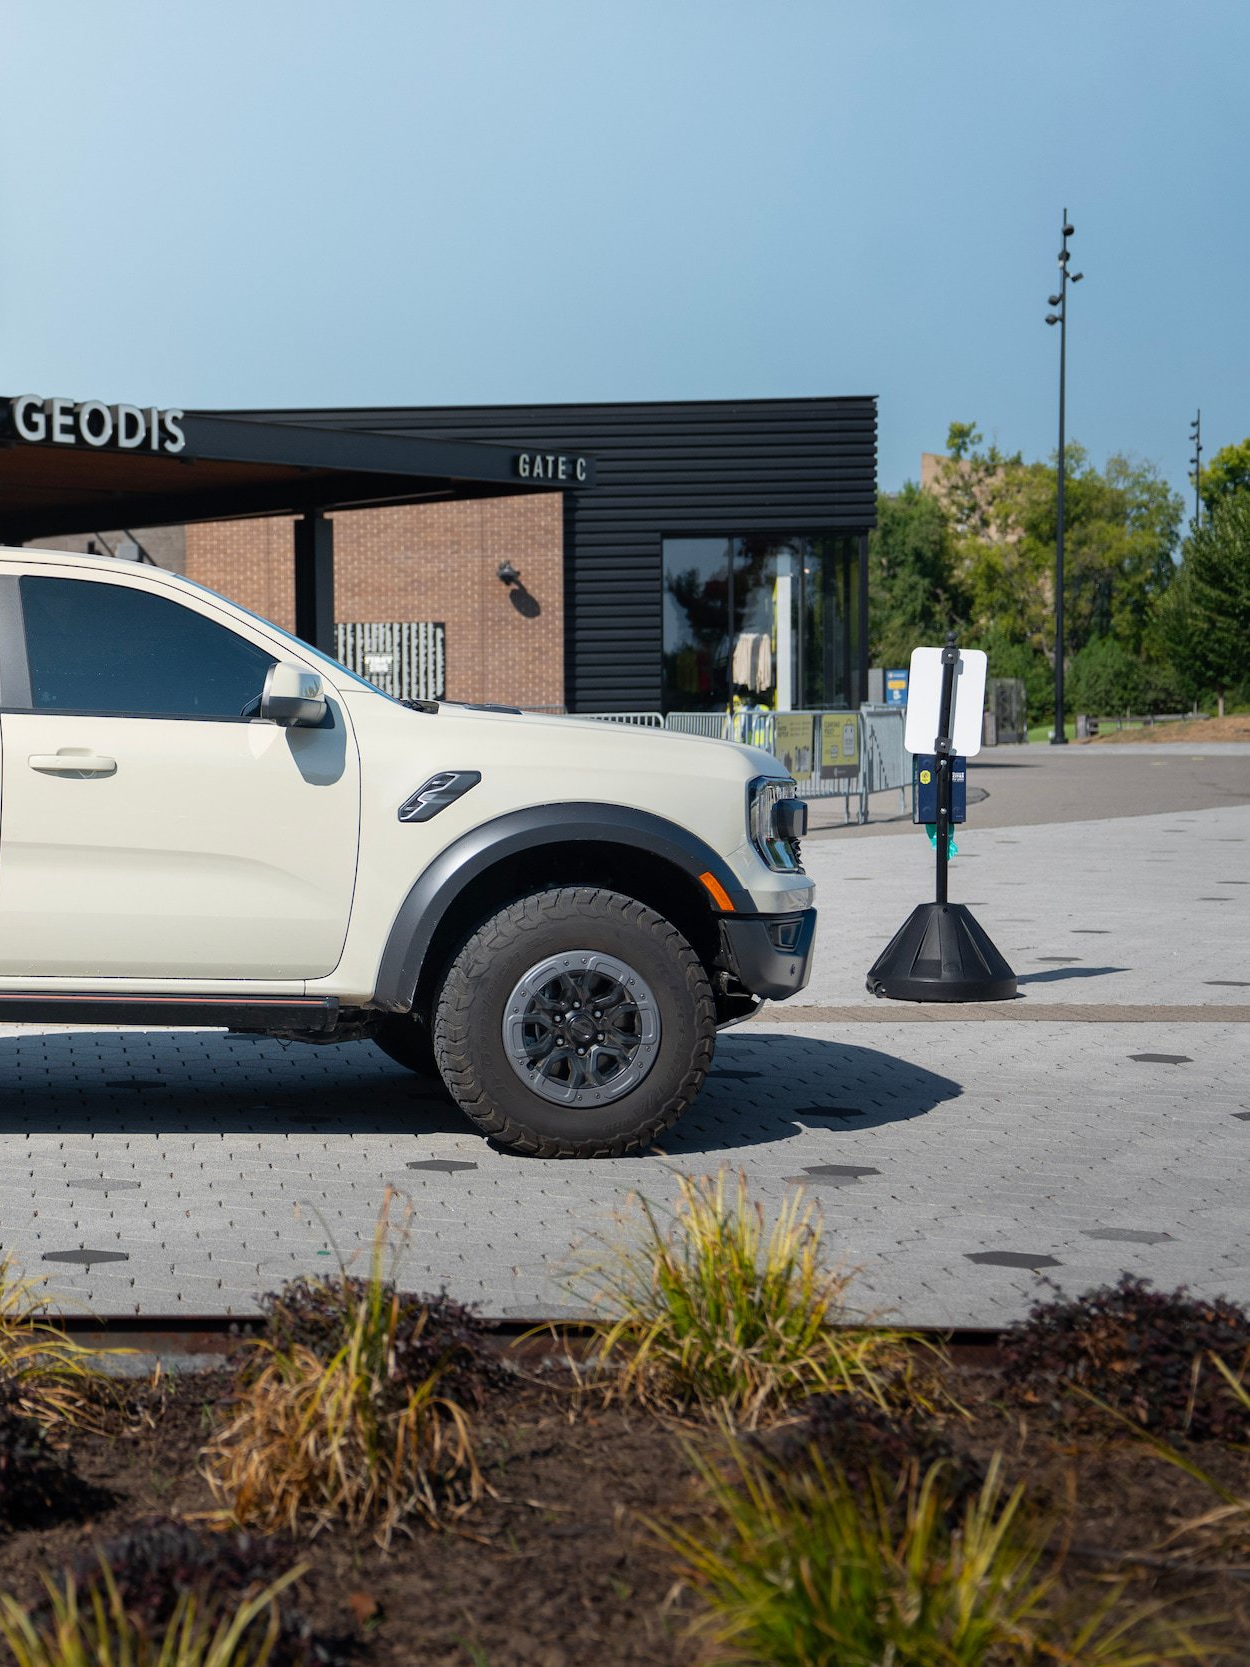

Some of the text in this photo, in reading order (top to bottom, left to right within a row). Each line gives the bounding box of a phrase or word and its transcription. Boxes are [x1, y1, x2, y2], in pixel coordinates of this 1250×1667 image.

[13, 394, 186, 454] GEODIS
[518, 453, 587, 482] GATE C
